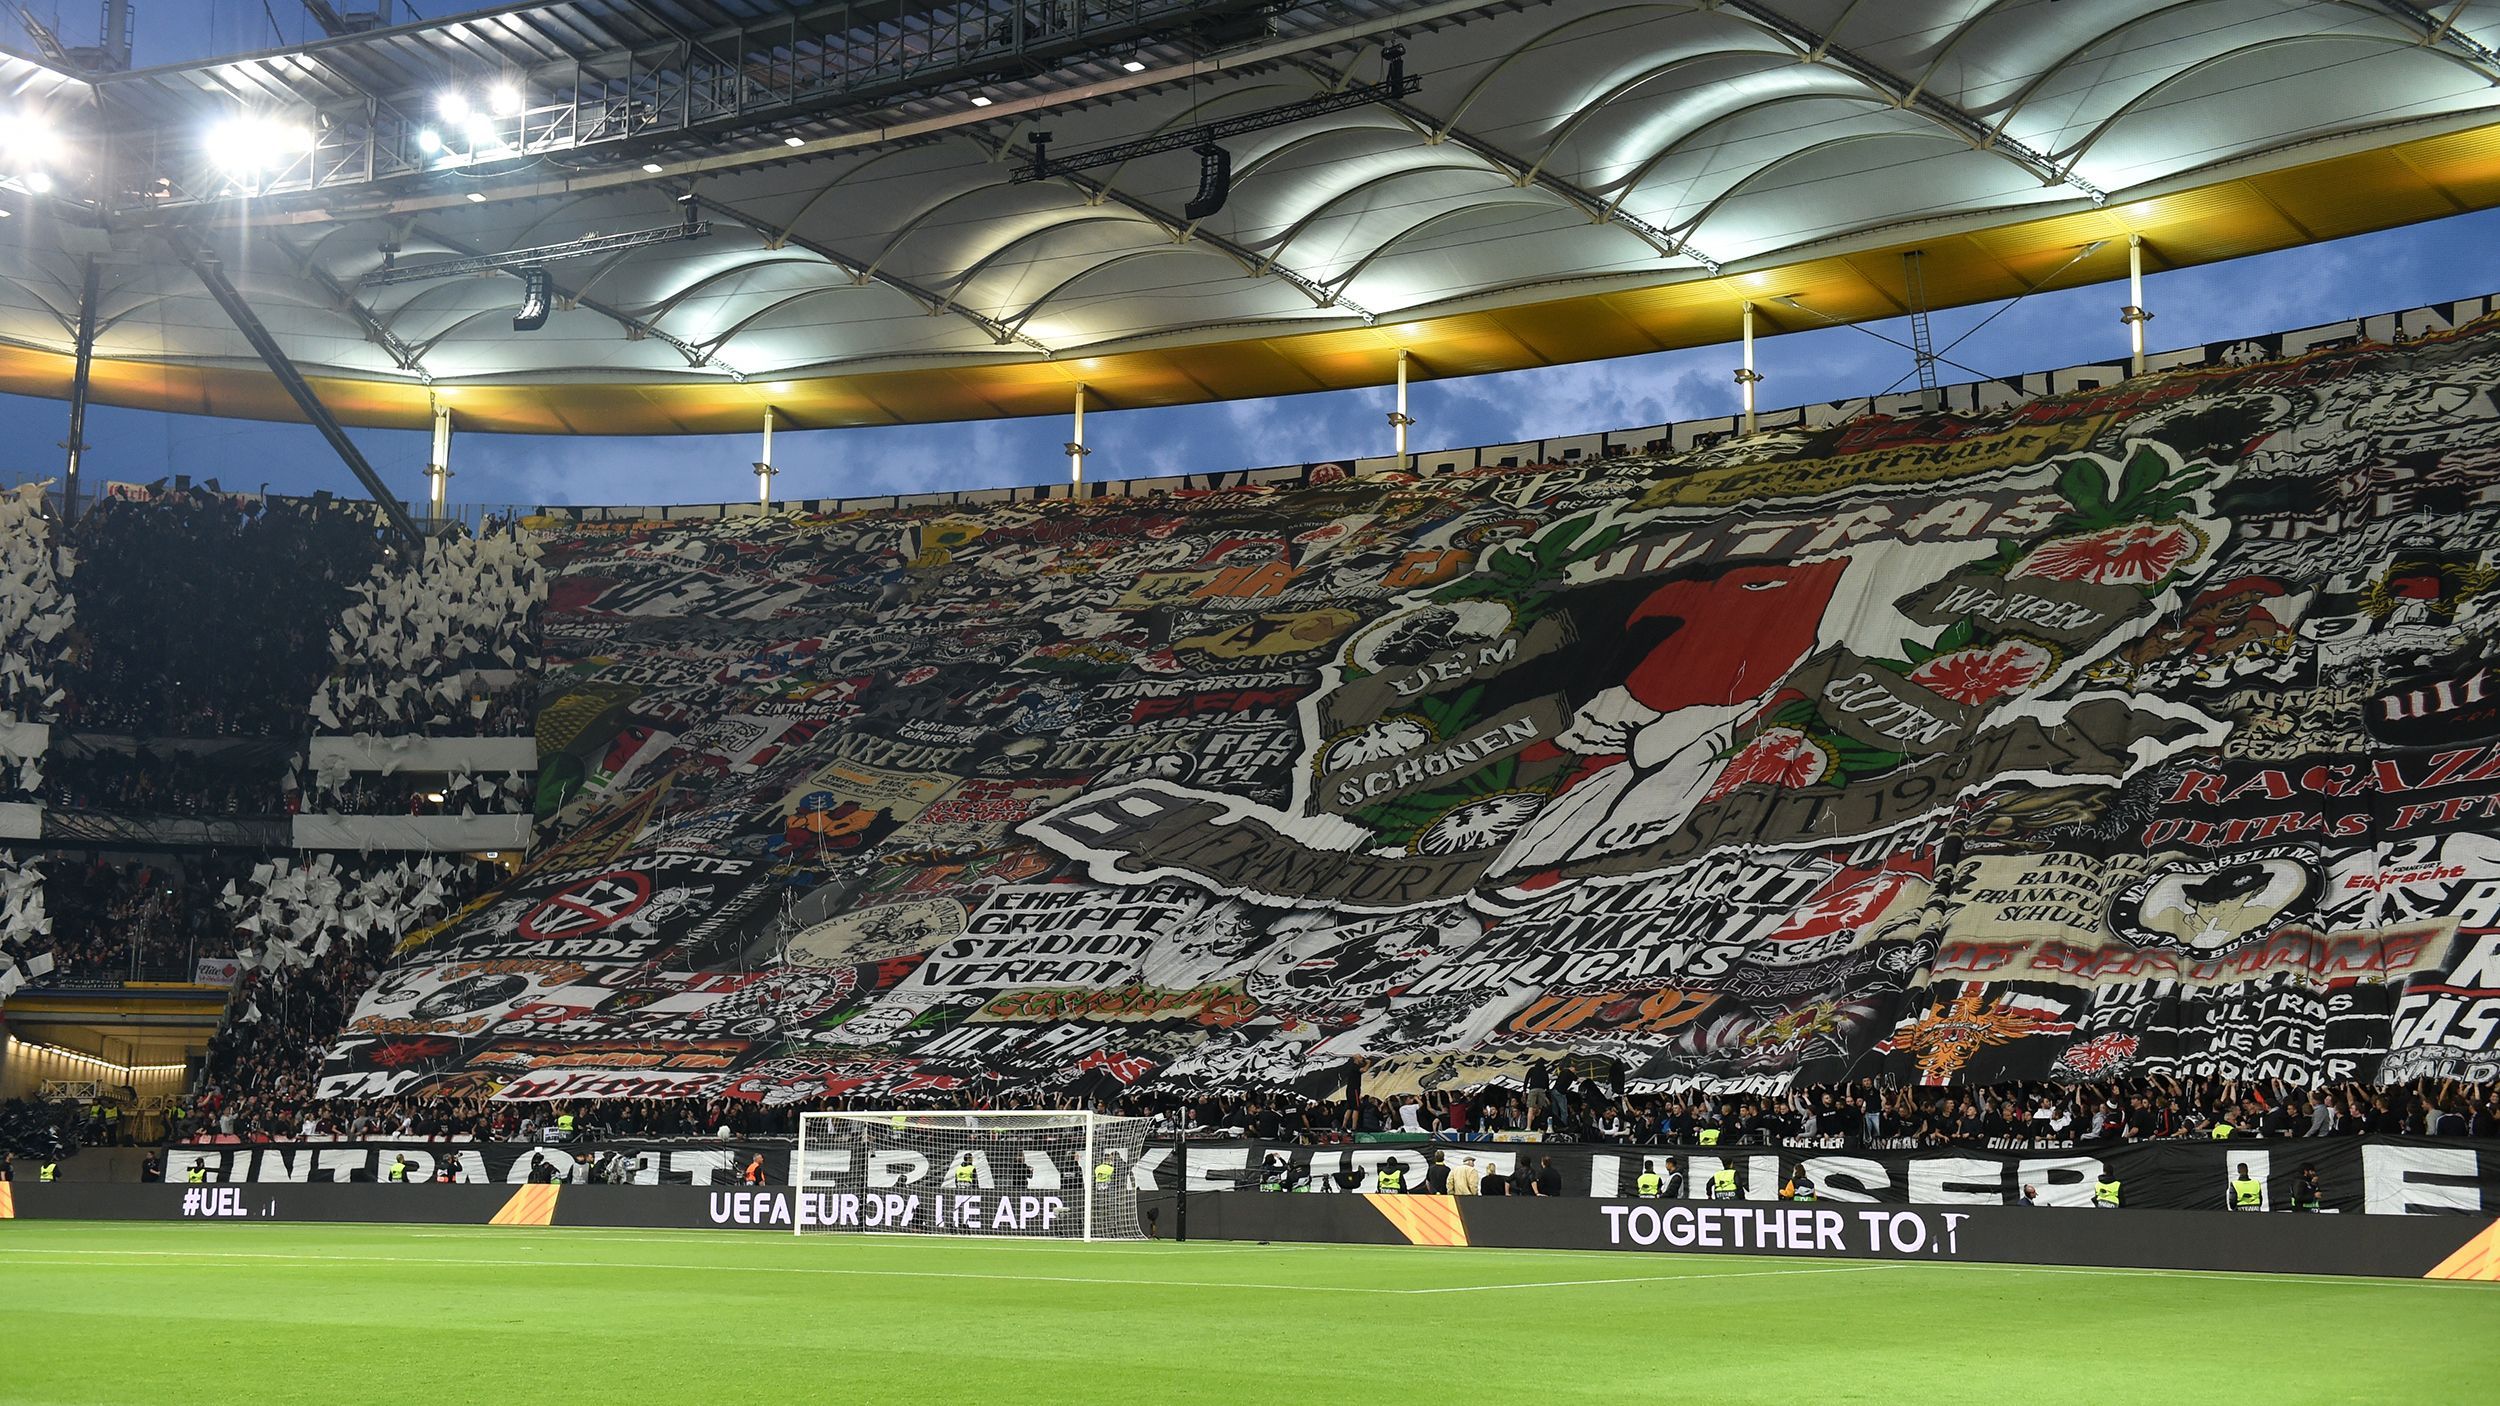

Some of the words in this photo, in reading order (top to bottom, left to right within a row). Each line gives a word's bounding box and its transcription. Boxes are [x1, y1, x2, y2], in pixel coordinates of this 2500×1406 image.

[1562, 494, 2077, 586] ULTRAS
[1930, 584, 2106, 631] WAHREN
[1823, 672, 1962, 745] GUTEN
[1337, 714, 1540, 806] SCHÖNEN
[2143, 810, 2372, 848] ULTRAS
[517, 854, 754, 891] KORRUPTE
[987, 890, 1094, 911] EHRE
[1115, 884, 1200, 906] DER
[967, 906, 1185, 935] GRUPPE
[1994, 905, 2100, 934] SCHULE
[400, 938, 662, 967] BASTARDE
[941, 934, 1154, 960] STADION
[923, 959, 1132, 987] VERBOT
[1405, 946, 1745, 997] HOOLIGANS
[2206, 993, 2353, 1025] ULTRAS
[2209, 1025, 2326, 1051] NEVER
[183, 1188, 248, 1217] #UEL
[710, 1192, 793, 1225] UEFA
[800, 1193, 920, 1227] EUROPA
[1600, 1204, 1846, 1251] TOGETHER
